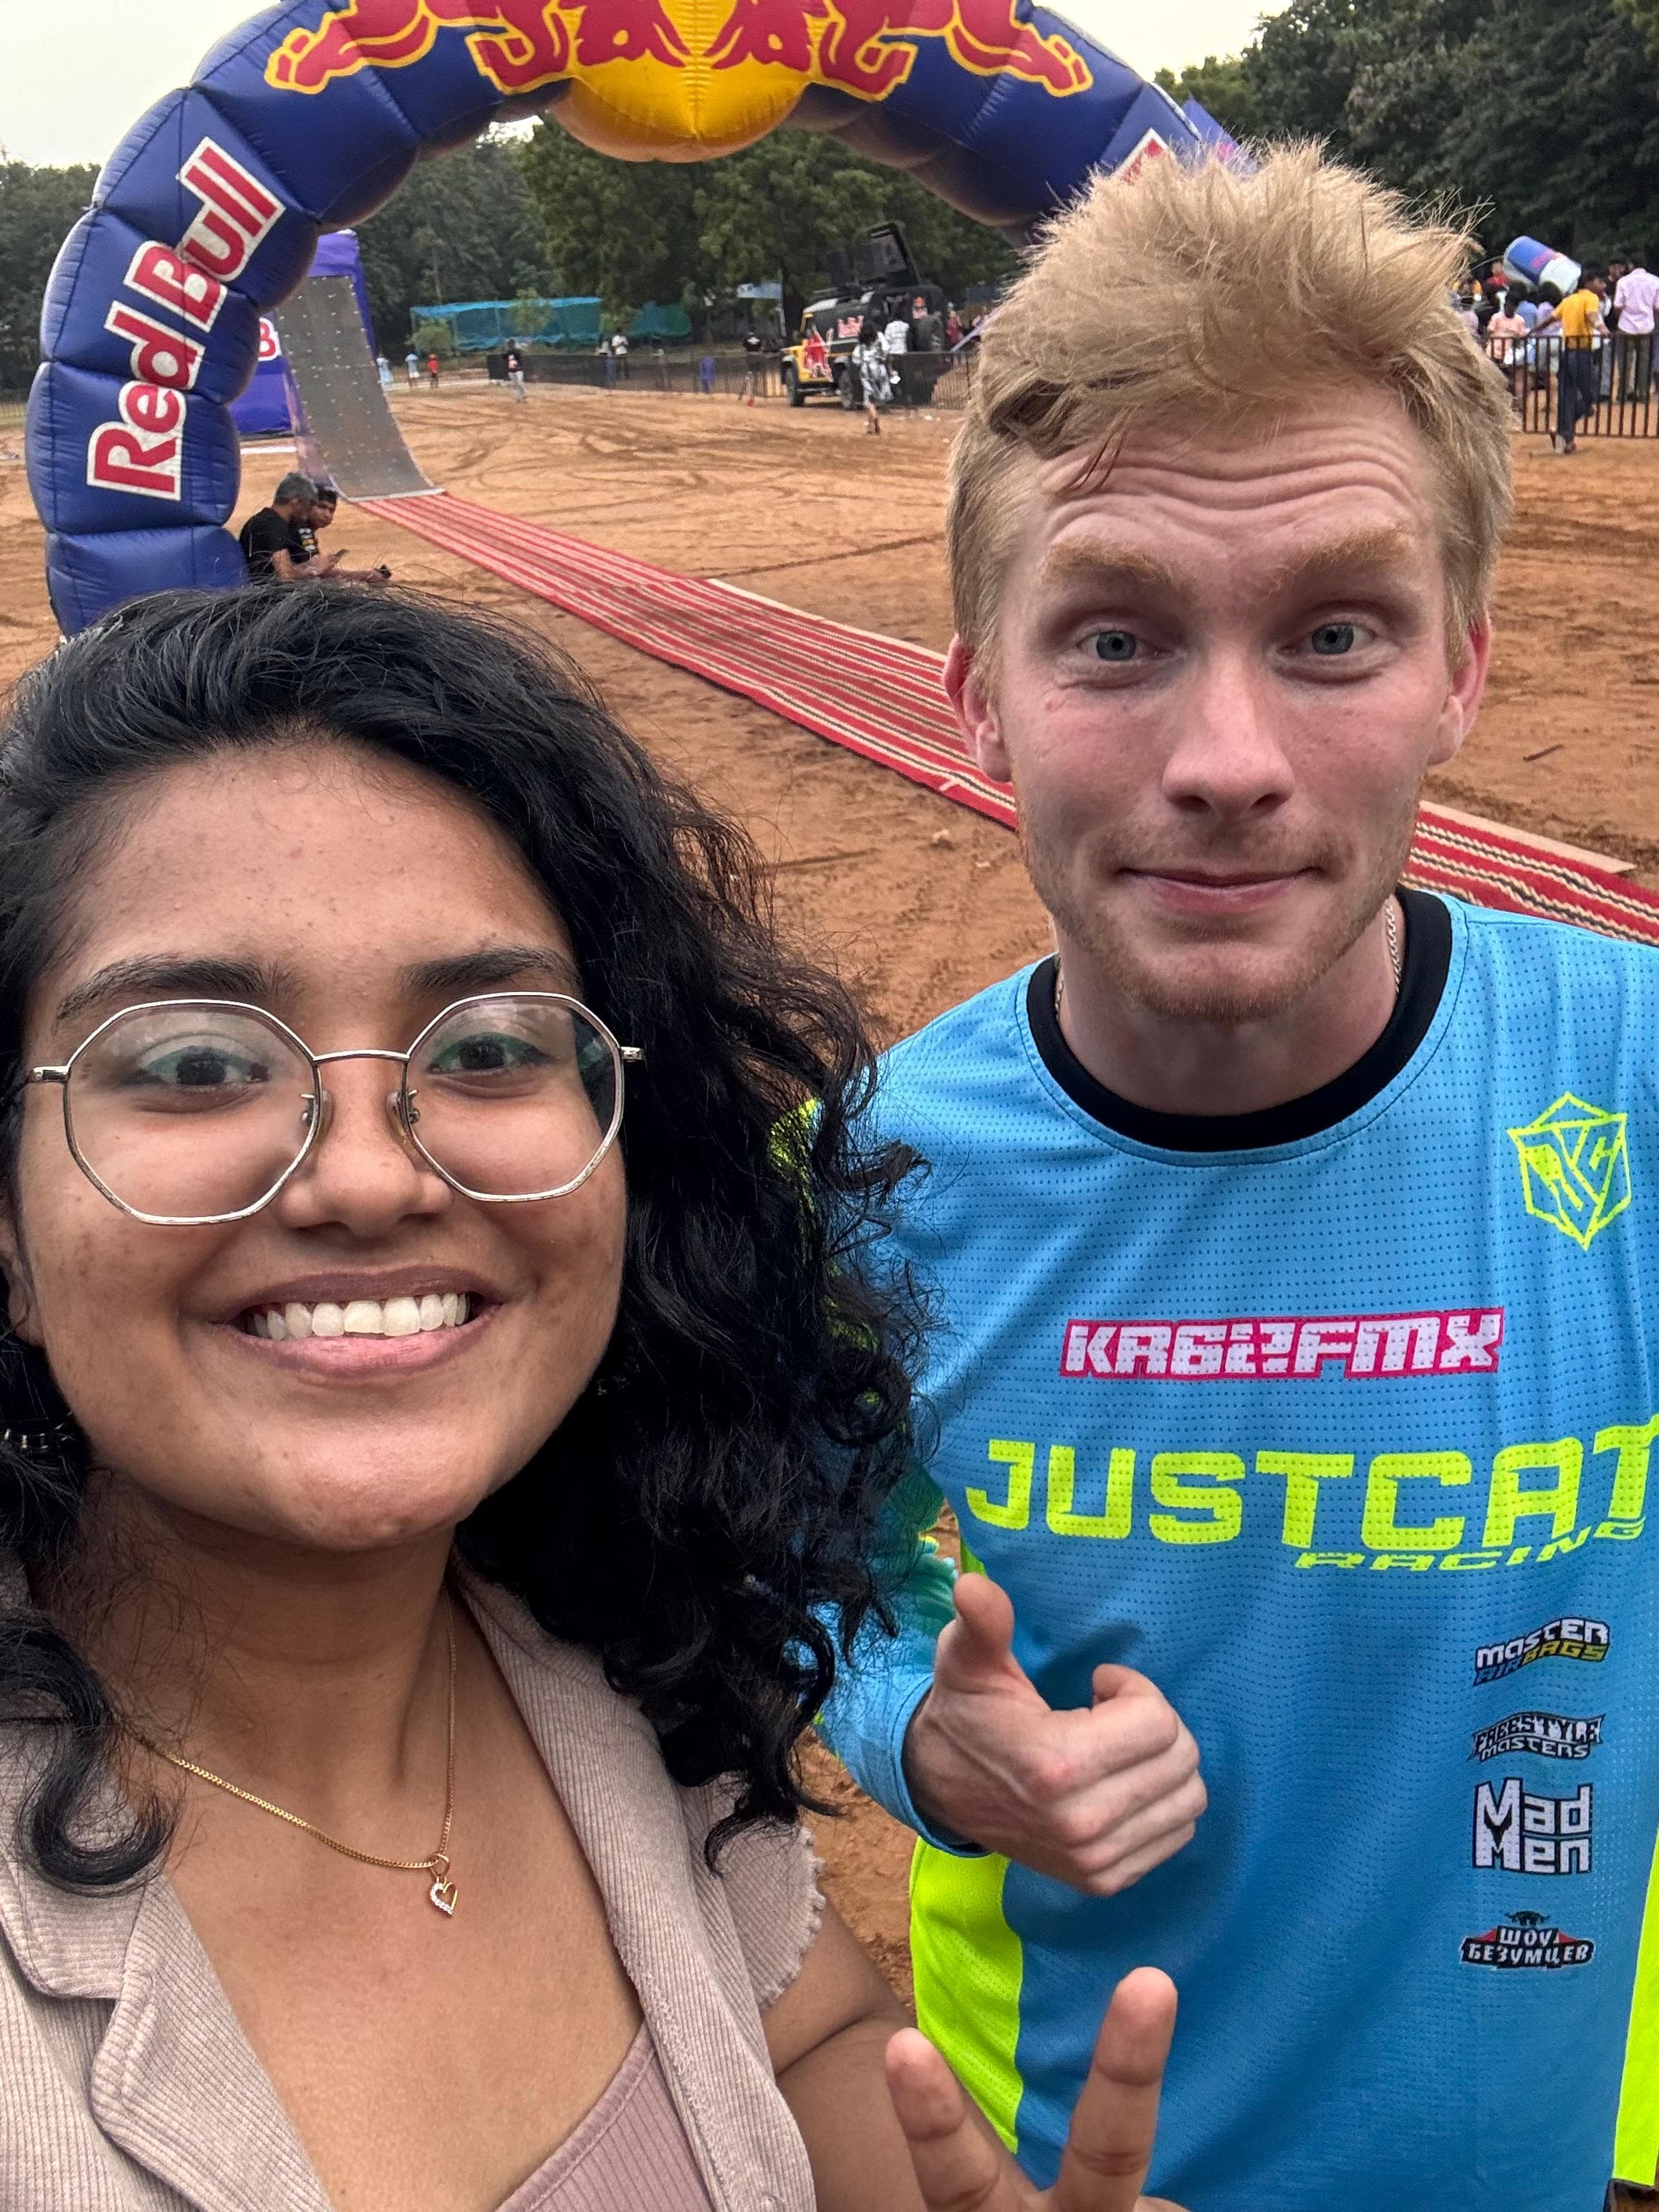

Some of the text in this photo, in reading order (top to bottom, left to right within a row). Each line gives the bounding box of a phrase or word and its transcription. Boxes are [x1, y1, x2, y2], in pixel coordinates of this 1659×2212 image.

[87, 136, 285, 500] Red Bull
[1294, 1515, 1646, 1571] RACING
[1475, 1779, 1592, 1835] Mad
[1468, 1942, 1590, 1965] БЕЗУМЦЕВ
[1499, 1928, 1553, 1947] ШОУ
